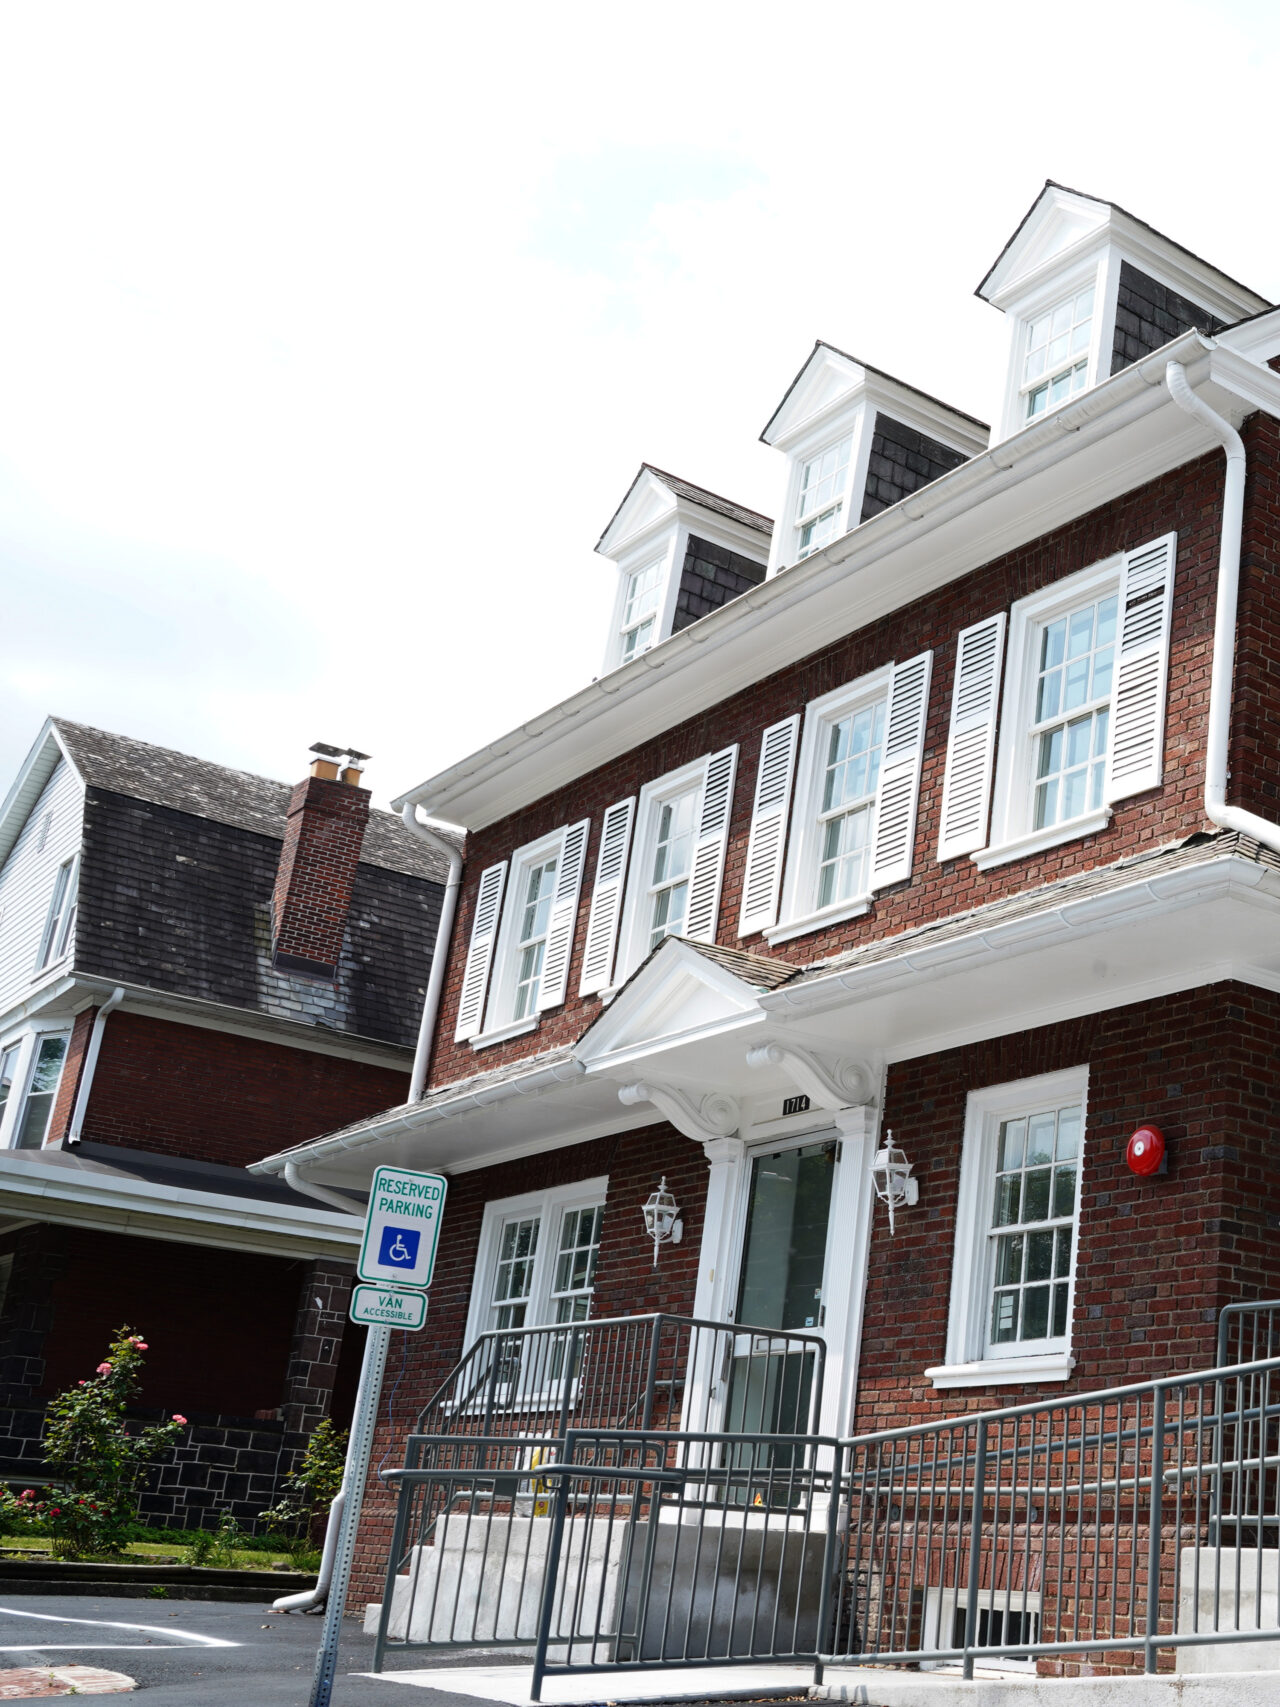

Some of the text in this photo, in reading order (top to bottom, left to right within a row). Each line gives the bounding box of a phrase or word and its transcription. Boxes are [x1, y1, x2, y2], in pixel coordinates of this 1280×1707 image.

[786, 1096, 806, 1113] 1714
[378, 1177, 440, 1201] RESERVED
[378, 1197, 433, 1219] PARKING
[378, 1296, 403, 1309] VAN
[363, 1307, 413, 1320] ACCESSIBLE
